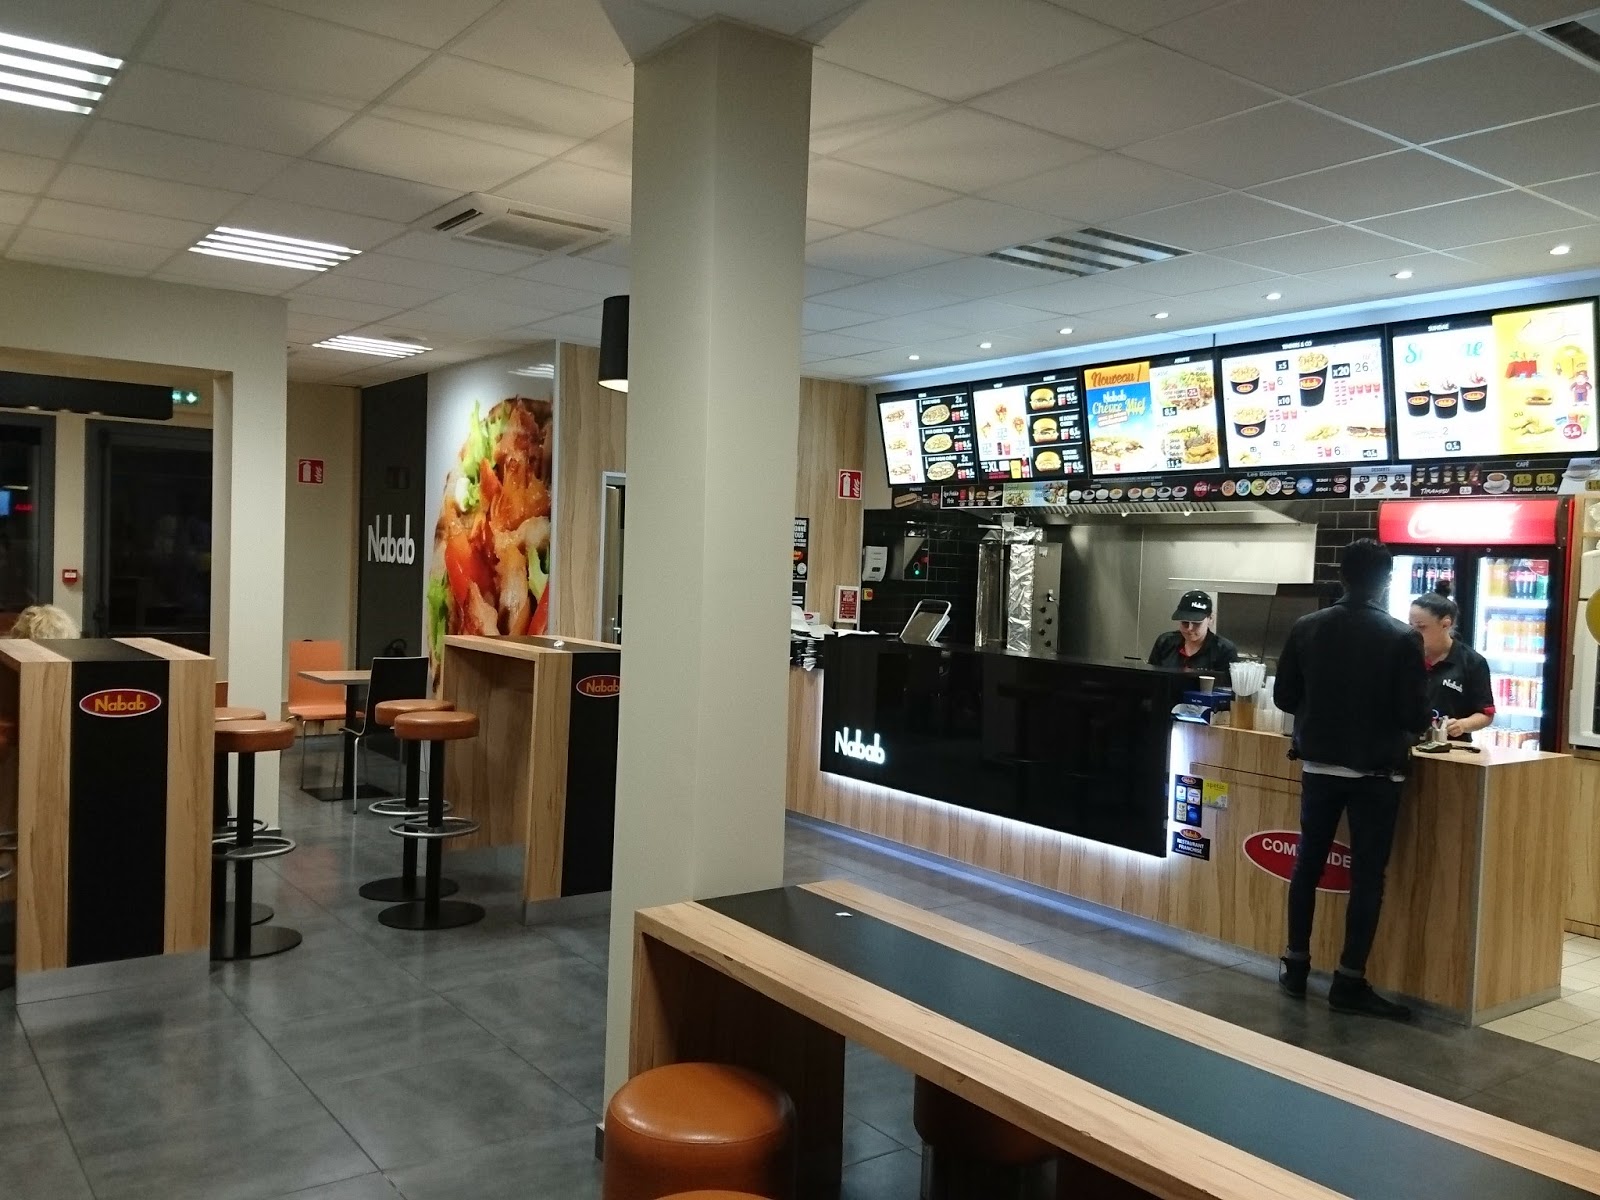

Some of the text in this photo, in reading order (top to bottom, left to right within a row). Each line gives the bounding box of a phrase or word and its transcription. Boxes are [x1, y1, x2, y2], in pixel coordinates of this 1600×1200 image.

[1333, 366, 1350, 377] x20
[1091, 372, 1135, 387] Nouveau
[1103, 389, 1127, 402] Nabab
[368, 514, 415, 565] Nabab
[586, 679, 620, 693] Nabab
[1442, 679, 1463, 693] Nabab
[94, 694, 146, 711] Nabab
[834, 726, 885, 764] Nabab
[1177, 838, 1205, 849] RESTAURANT
